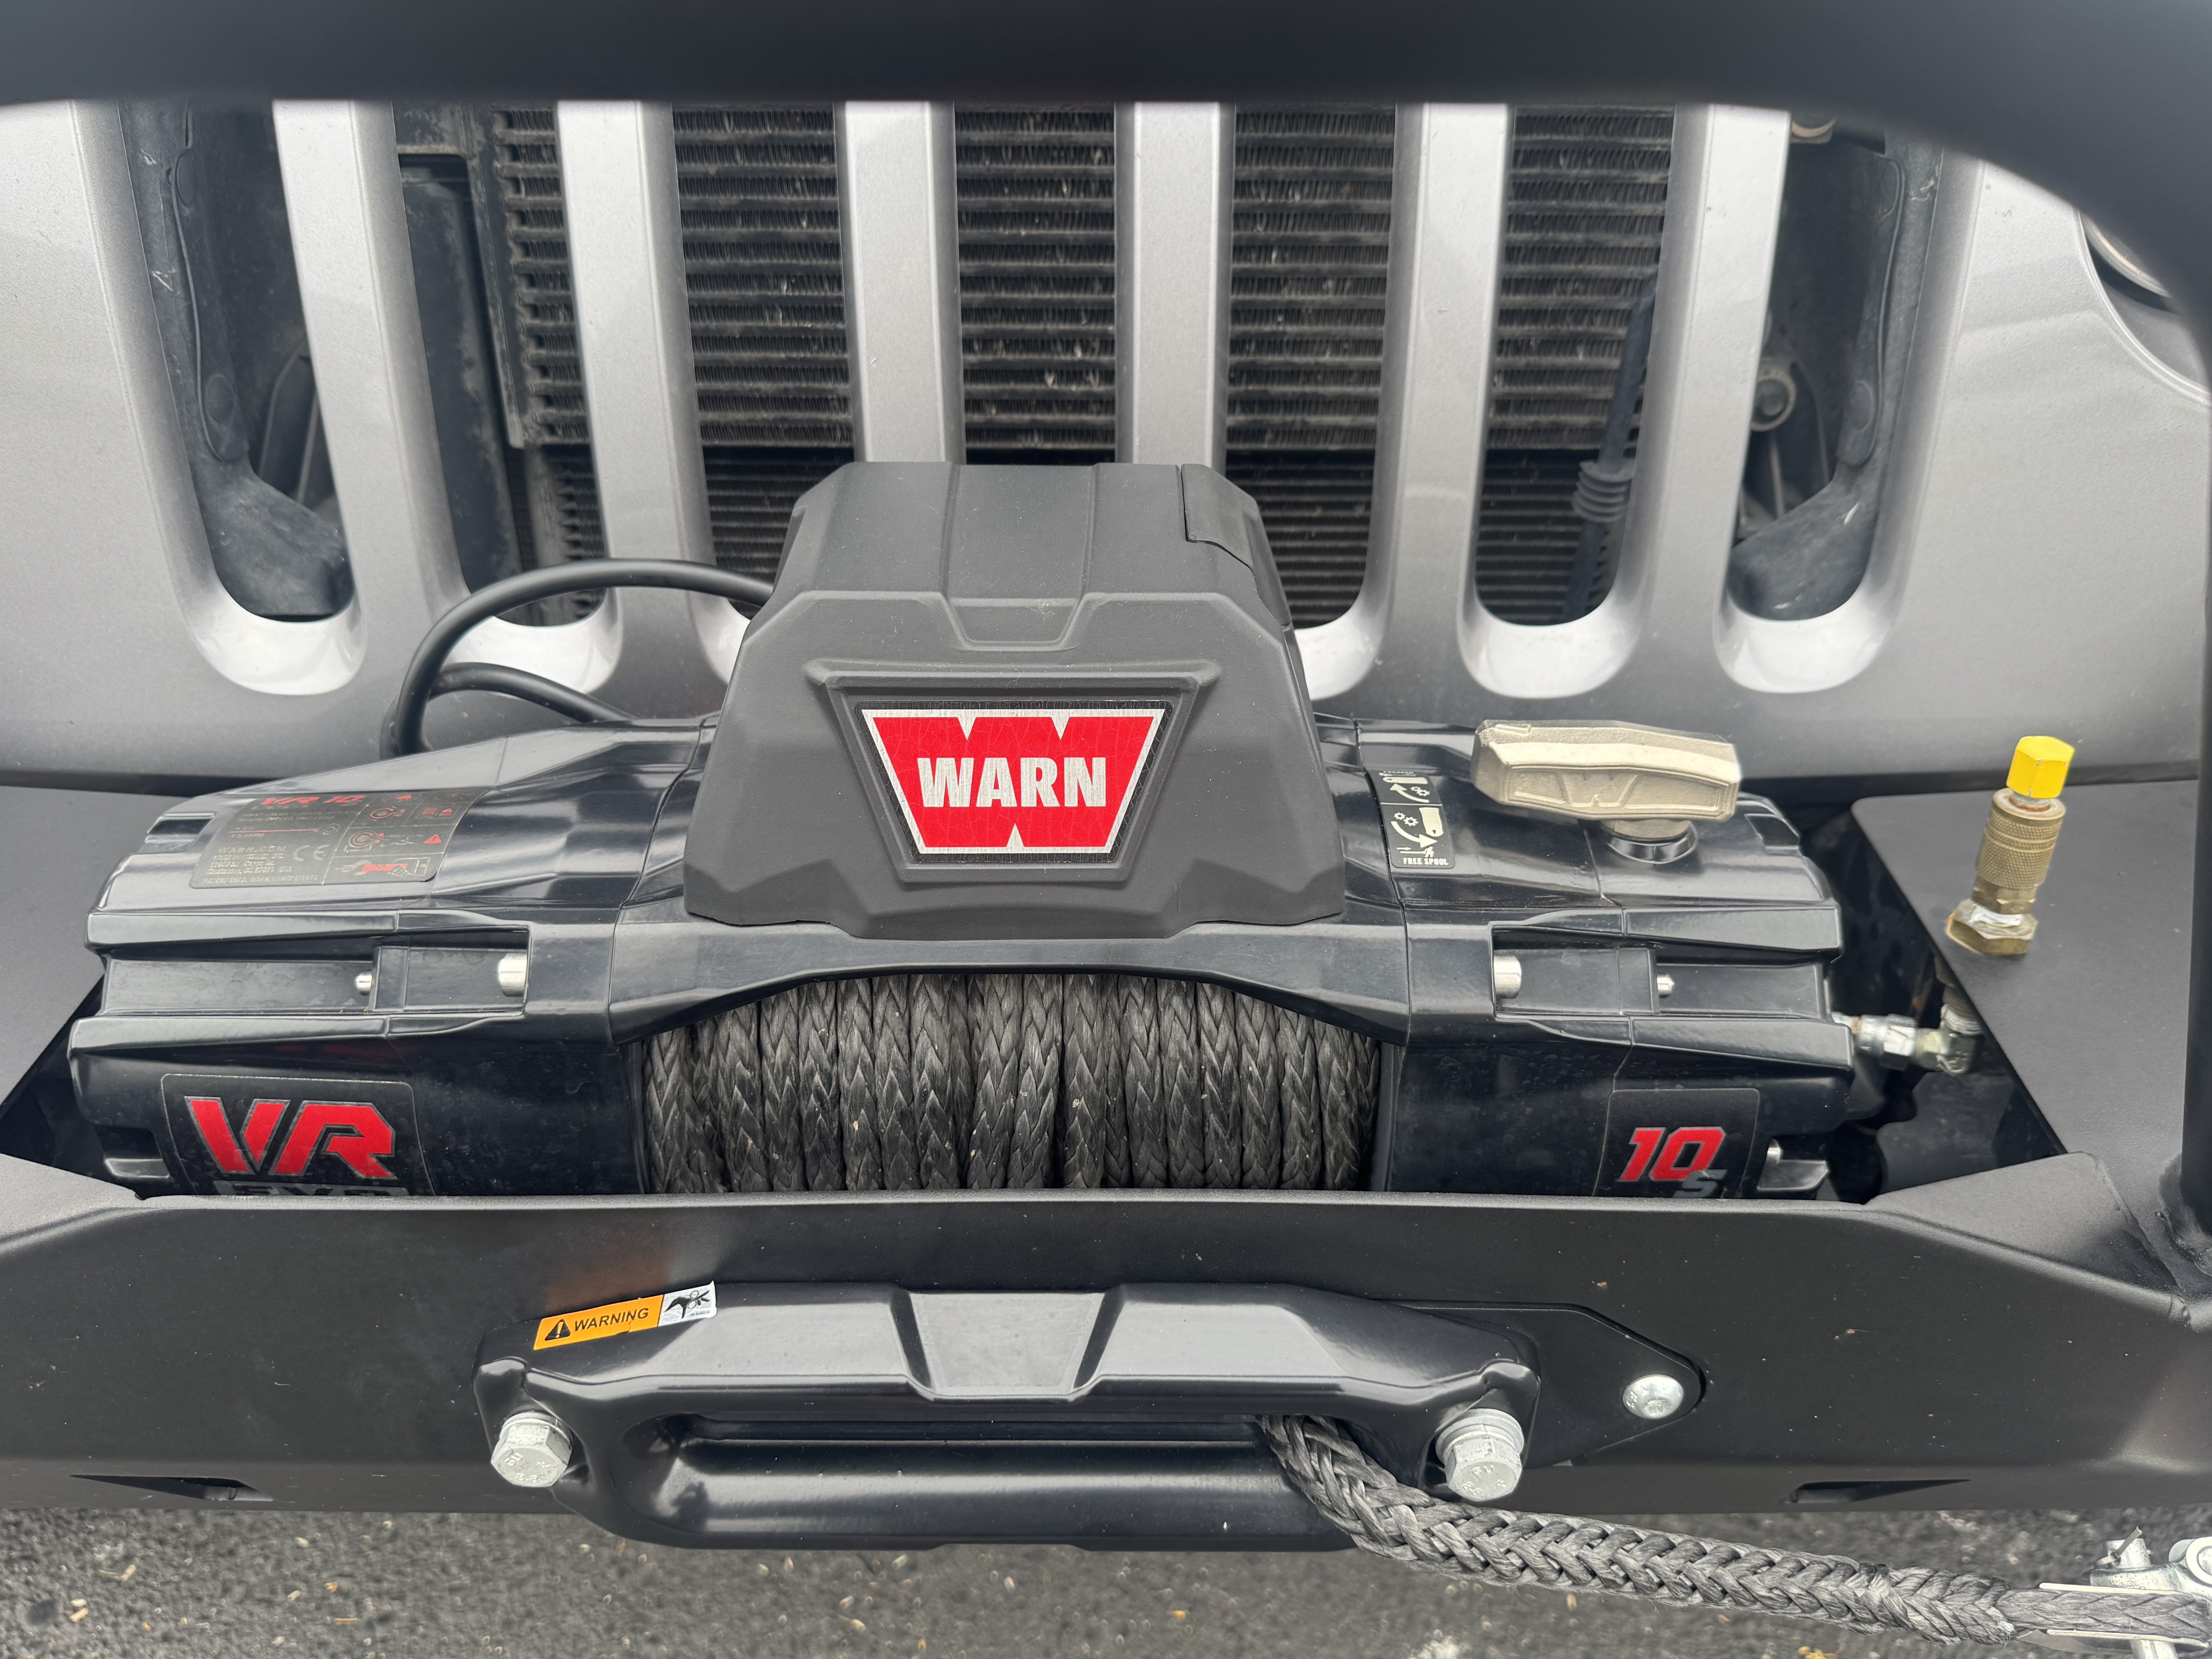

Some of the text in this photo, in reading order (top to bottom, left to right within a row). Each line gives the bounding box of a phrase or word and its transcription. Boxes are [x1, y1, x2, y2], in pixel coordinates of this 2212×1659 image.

[917, 757, 1106, 807] WARN
[184, 1096, 399, 1180] VR
[1617, 1126, 1726, 1182] 10
[574, 1308, 649, 1332] WARNING
